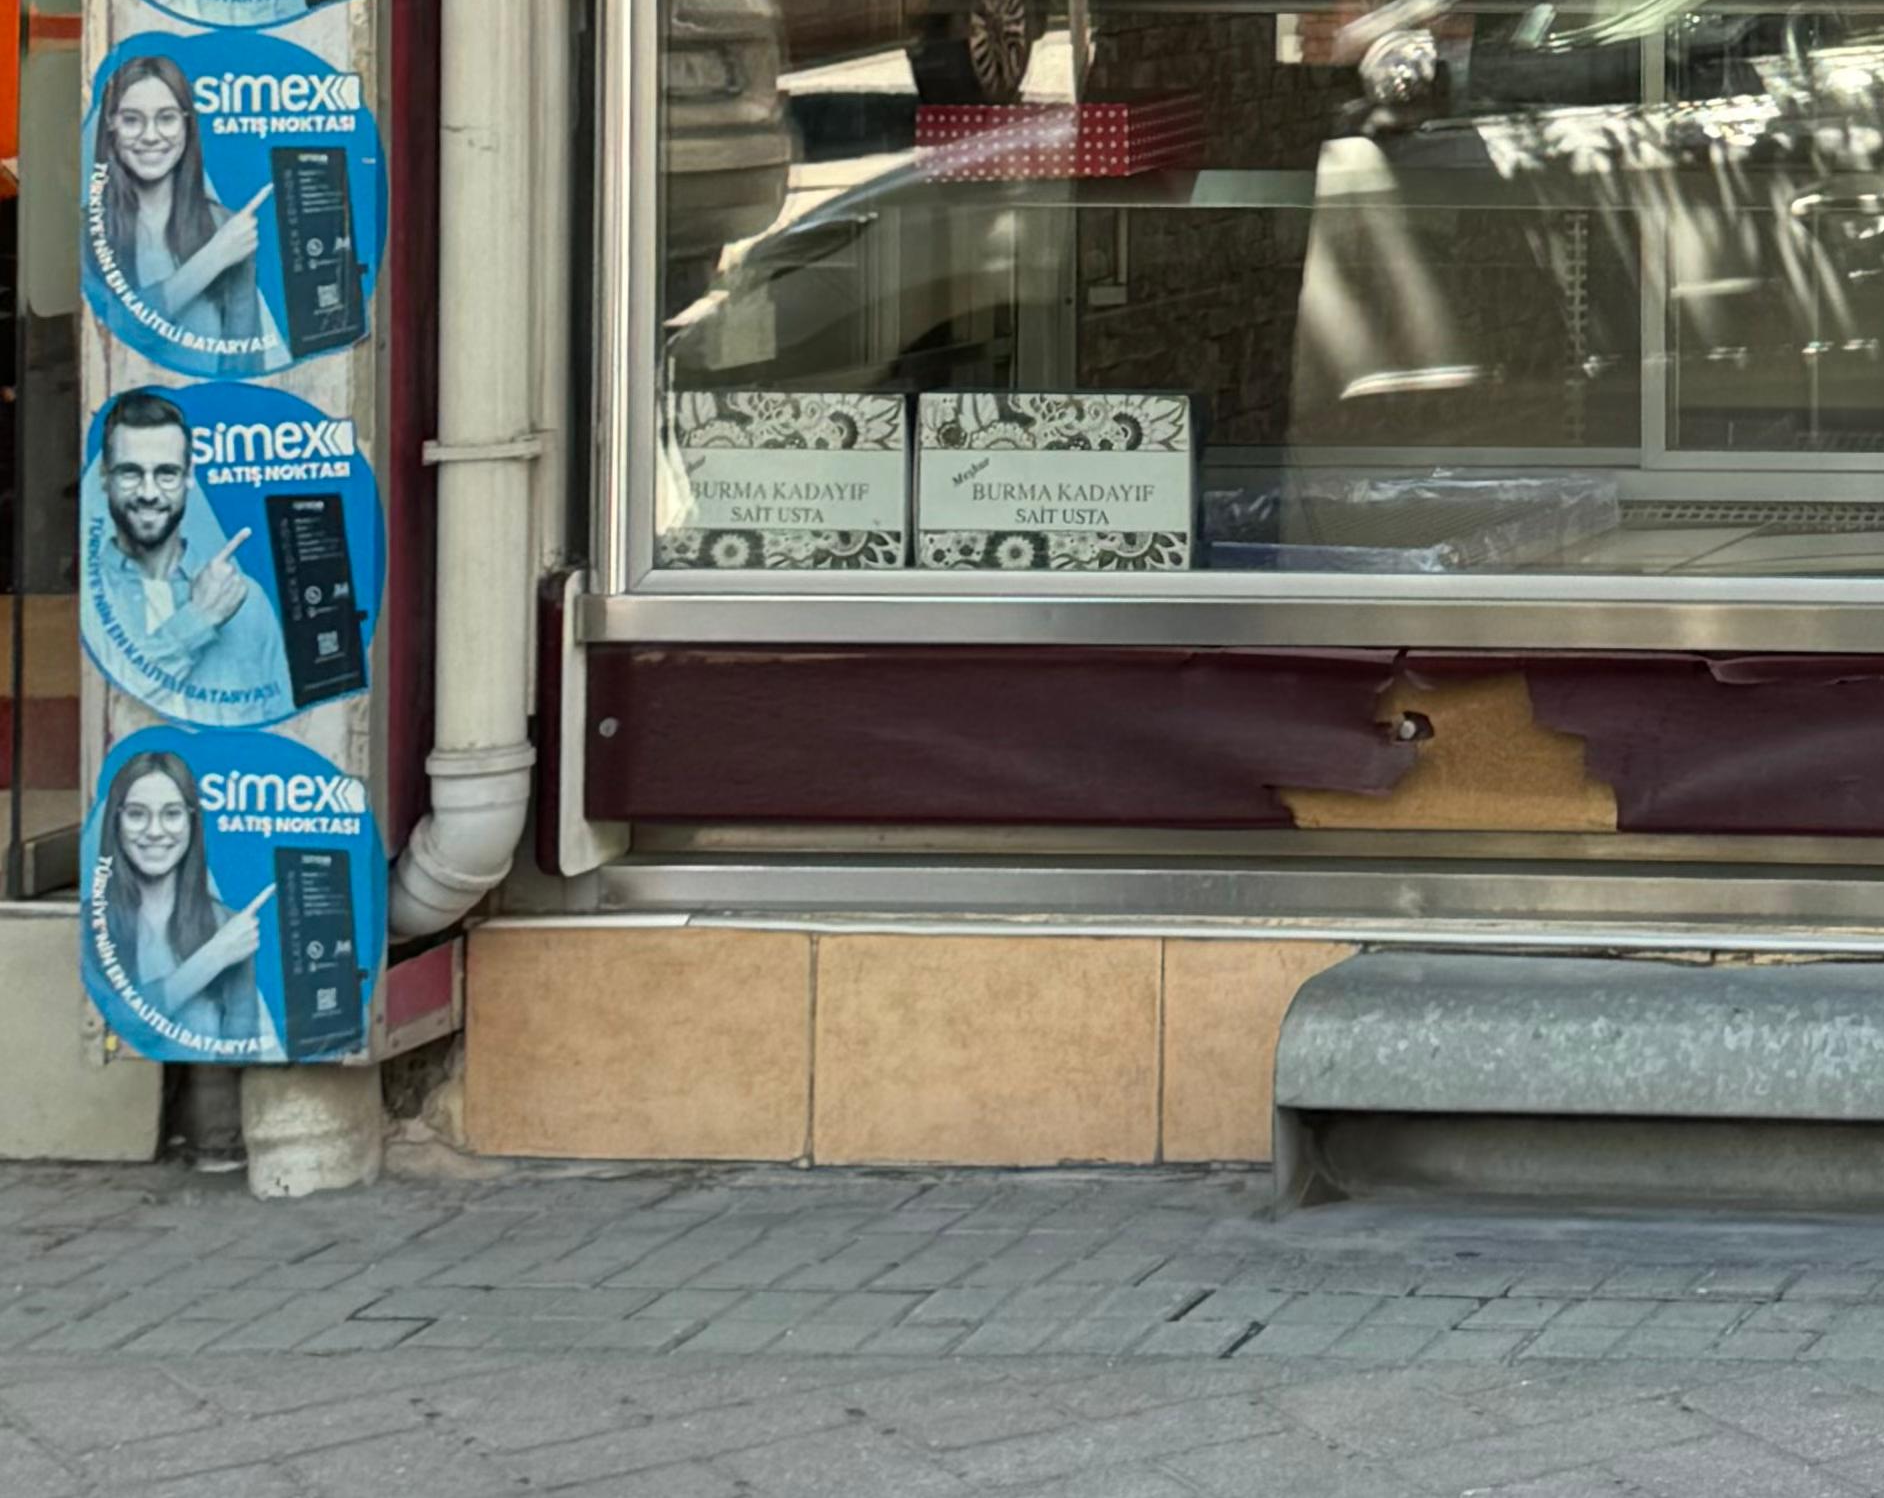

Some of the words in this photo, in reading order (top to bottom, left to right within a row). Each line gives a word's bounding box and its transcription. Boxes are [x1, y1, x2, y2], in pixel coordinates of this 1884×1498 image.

[193, 73, 337, 114] simex
[212, 116, 268, 139] SATIŞ
[271, 114, 356, 133] NOKTASI
[191, 420, 330, 464] simex
[207, 466, 263, 488] SATIŞ
[265, 462, 351, 481] NOKTASI
[690, 481, 767, 501] BURMA
[772, 481, 870, 502] KADAYIF
[972, 482, 1052, 502] BURMA
[1057, 482, 1155, 502] KADAYIF
[730, 504, 774, 523] SAİT
[778, 507, 825, 523] USTA
[1014, 505, 1058, 525] SAİT
[1062, 508, 1110, 525] USTA
[199, 770, 342, 813] simex
[217, 813, 273, 838] SATIŞ
[275, 816, 361, 835] NOKTASI
